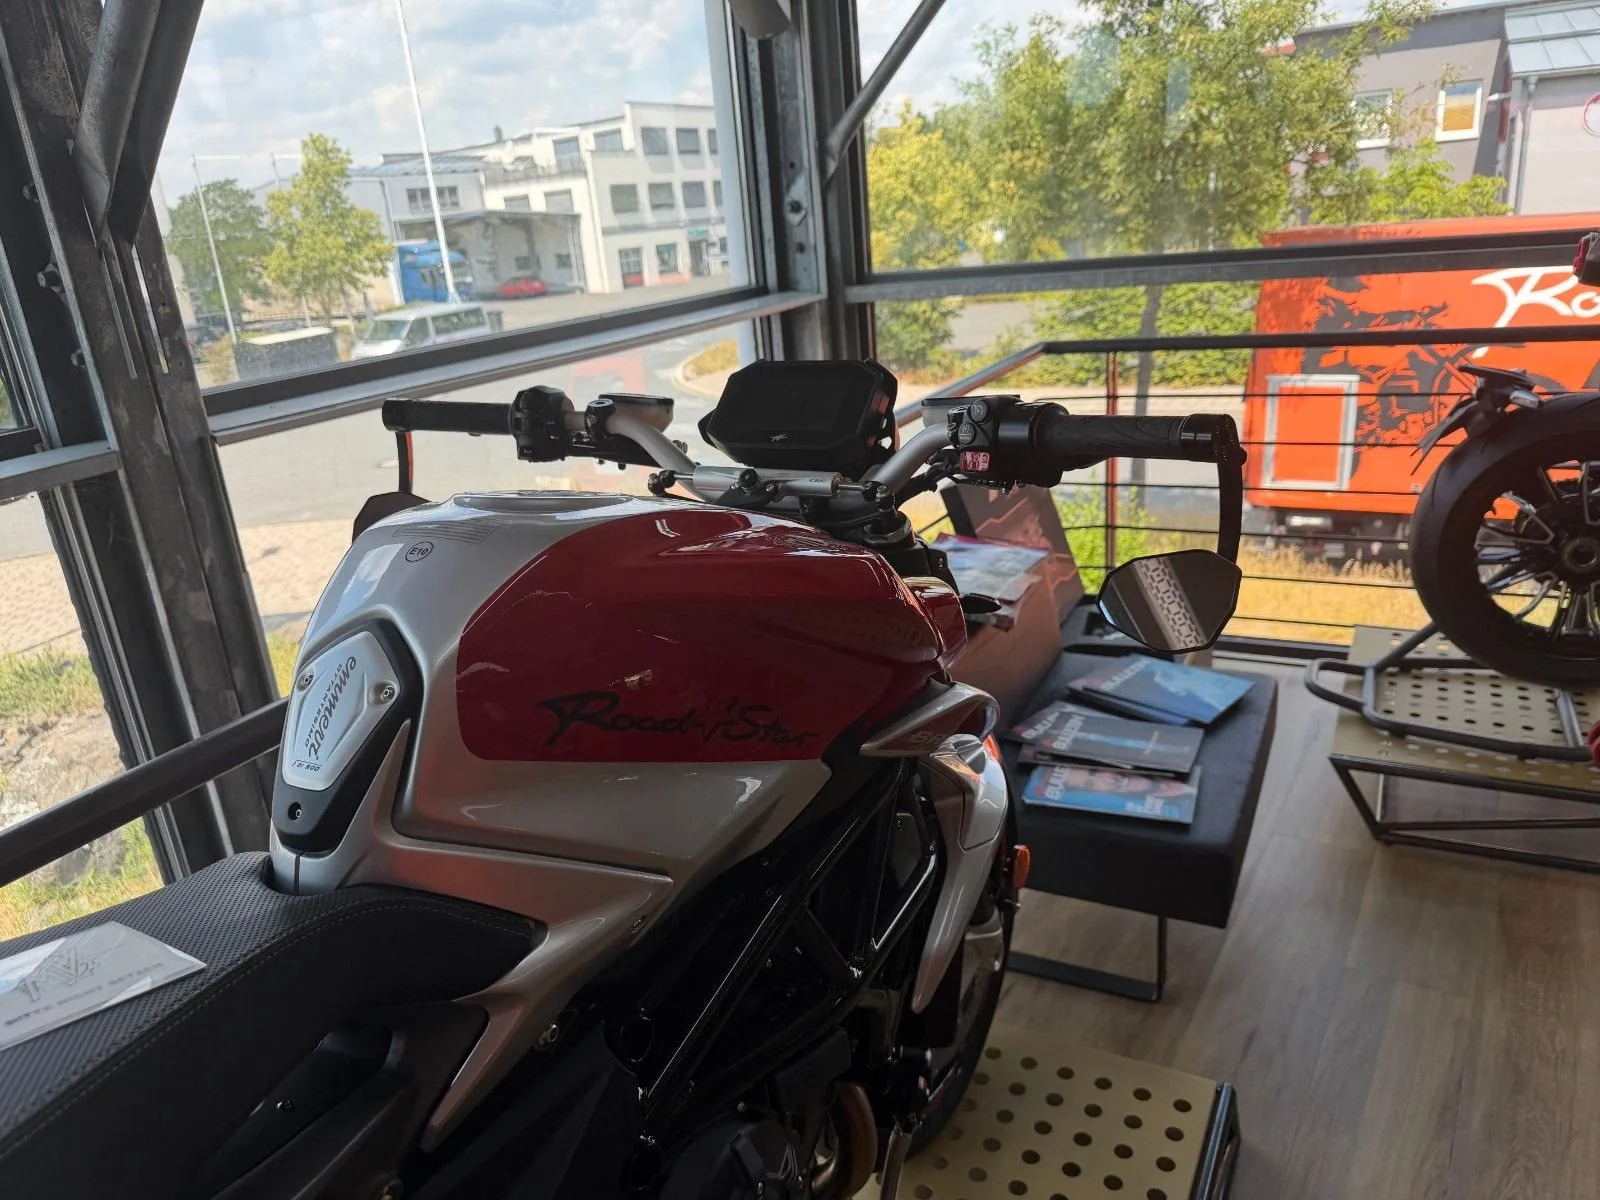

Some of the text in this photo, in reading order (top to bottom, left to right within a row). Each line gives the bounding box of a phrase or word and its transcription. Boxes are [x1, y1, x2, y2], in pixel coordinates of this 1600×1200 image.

[408, 547, 429, 556] E10
[535, 690, 819, 747] Road Star
